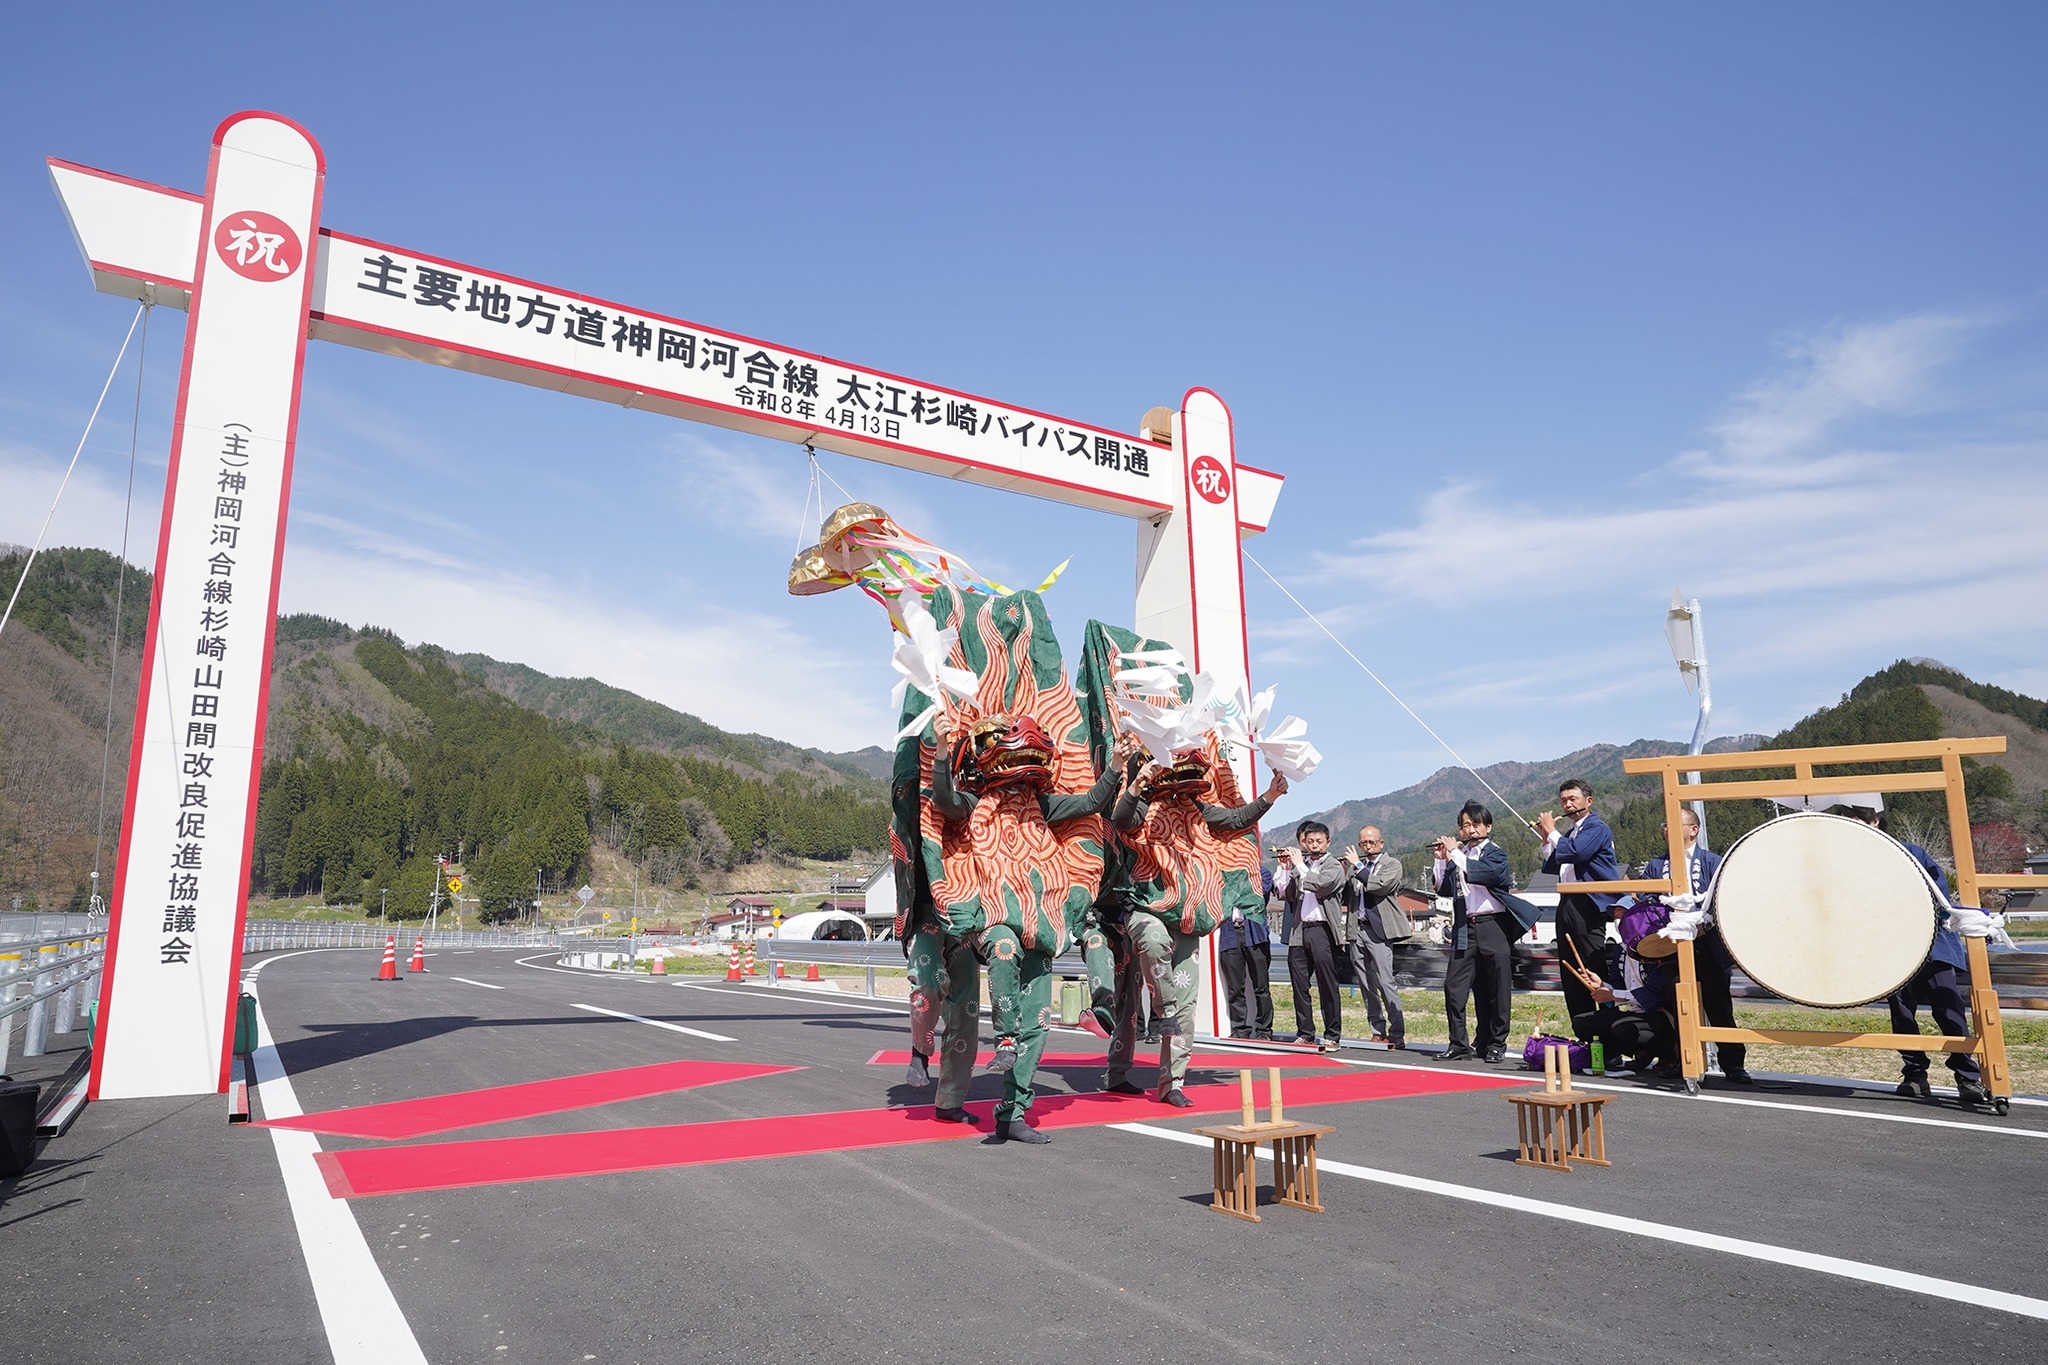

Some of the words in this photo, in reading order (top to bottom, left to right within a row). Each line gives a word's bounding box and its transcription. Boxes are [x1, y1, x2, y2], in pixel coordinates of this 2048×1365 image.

[225, 218, 290, 274] 祝
[357, 254, 820, 399] 主要地方道神岡河合線
[836, 374, 1150, 478] 太江杉崎バイパス開通
[735, 384, 816, 420] 令和8年
[825, 406, 900, 440] 4月13日
[1195, 460, 1228, 498] 祝
